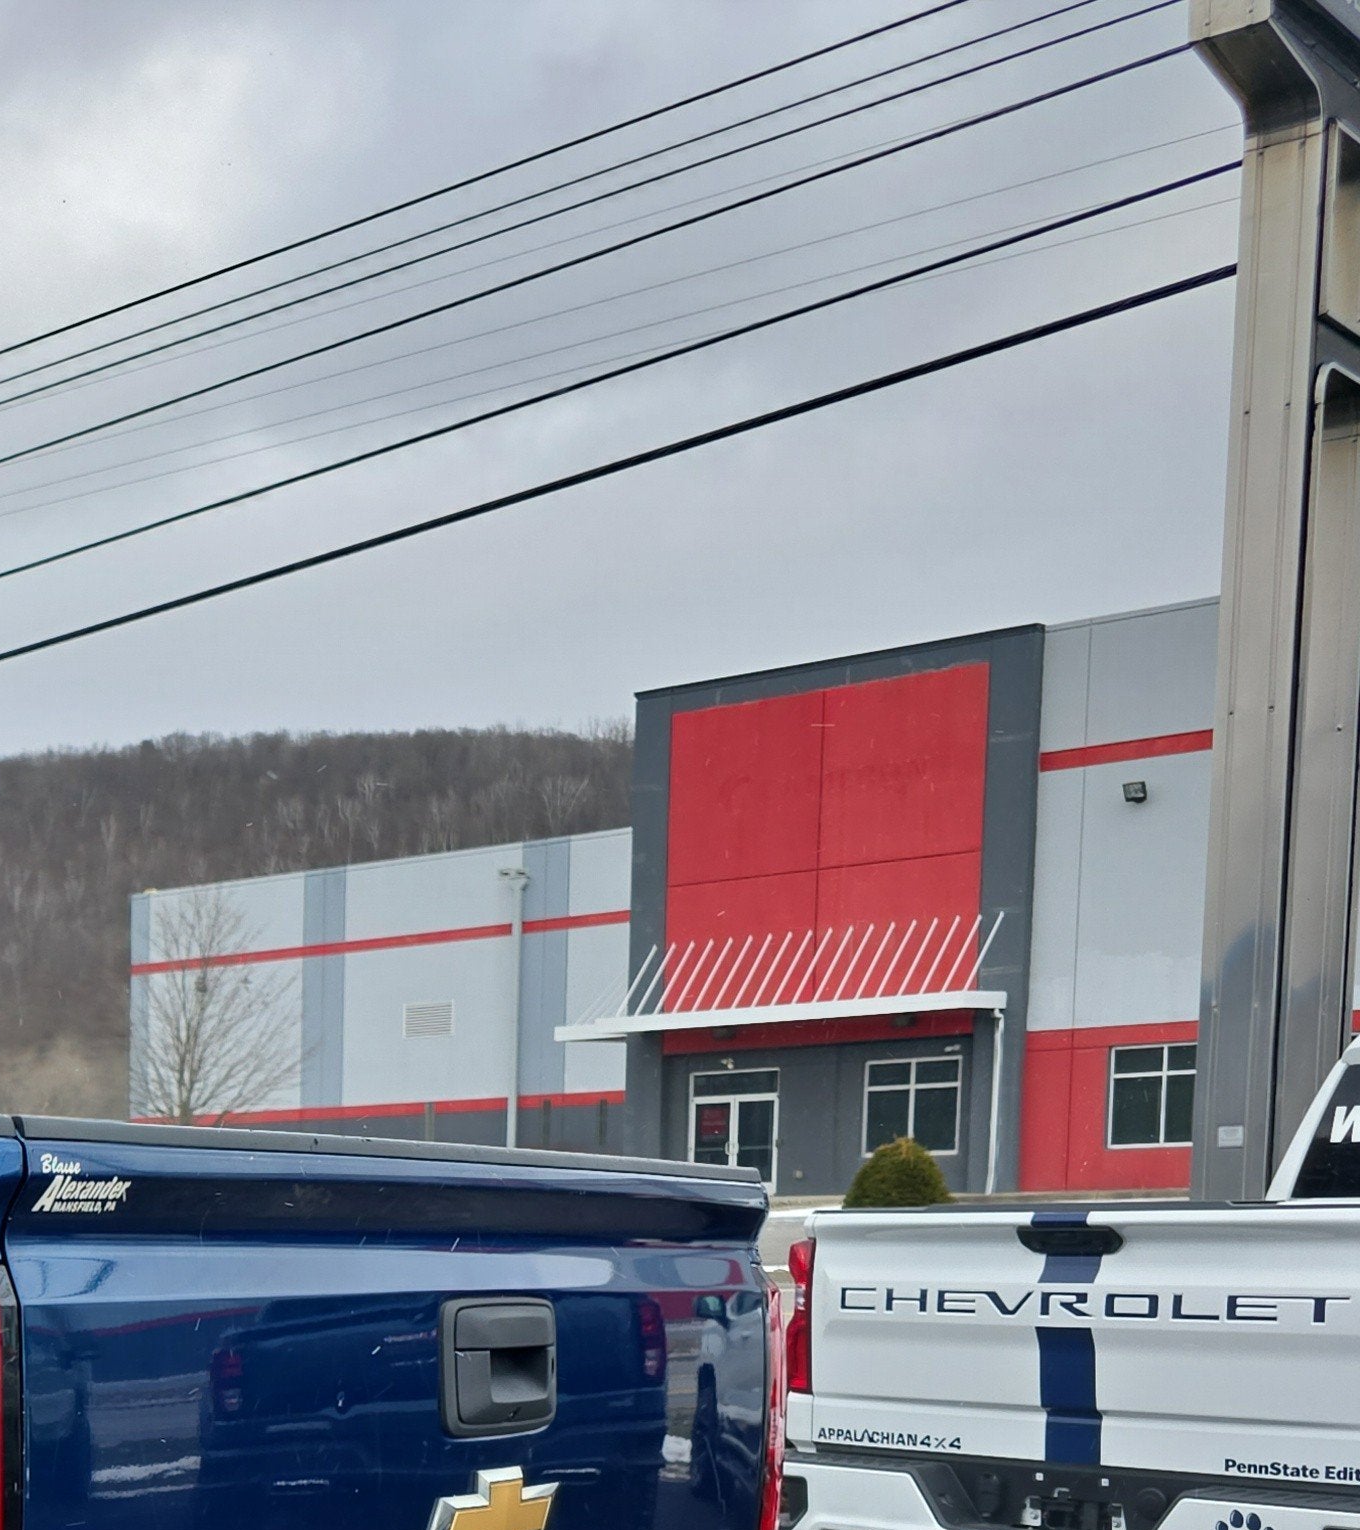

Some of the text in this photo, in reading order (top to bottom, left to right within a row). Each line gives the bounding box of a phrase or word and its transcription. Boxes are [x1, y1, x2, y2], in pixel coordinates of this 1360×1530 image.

[40, 1153, 81, 1174] Blaise
[31, 1175, 132, 1212] Alexander
[51, 1201, 117, 1214] MANSFIELD, PA
[839, 1287, 1352, 1325] CHEVROLET
[818, 1427, 918, 1447] APPALACHIAN
[1224, 1458, 1320, 1479] PennState
